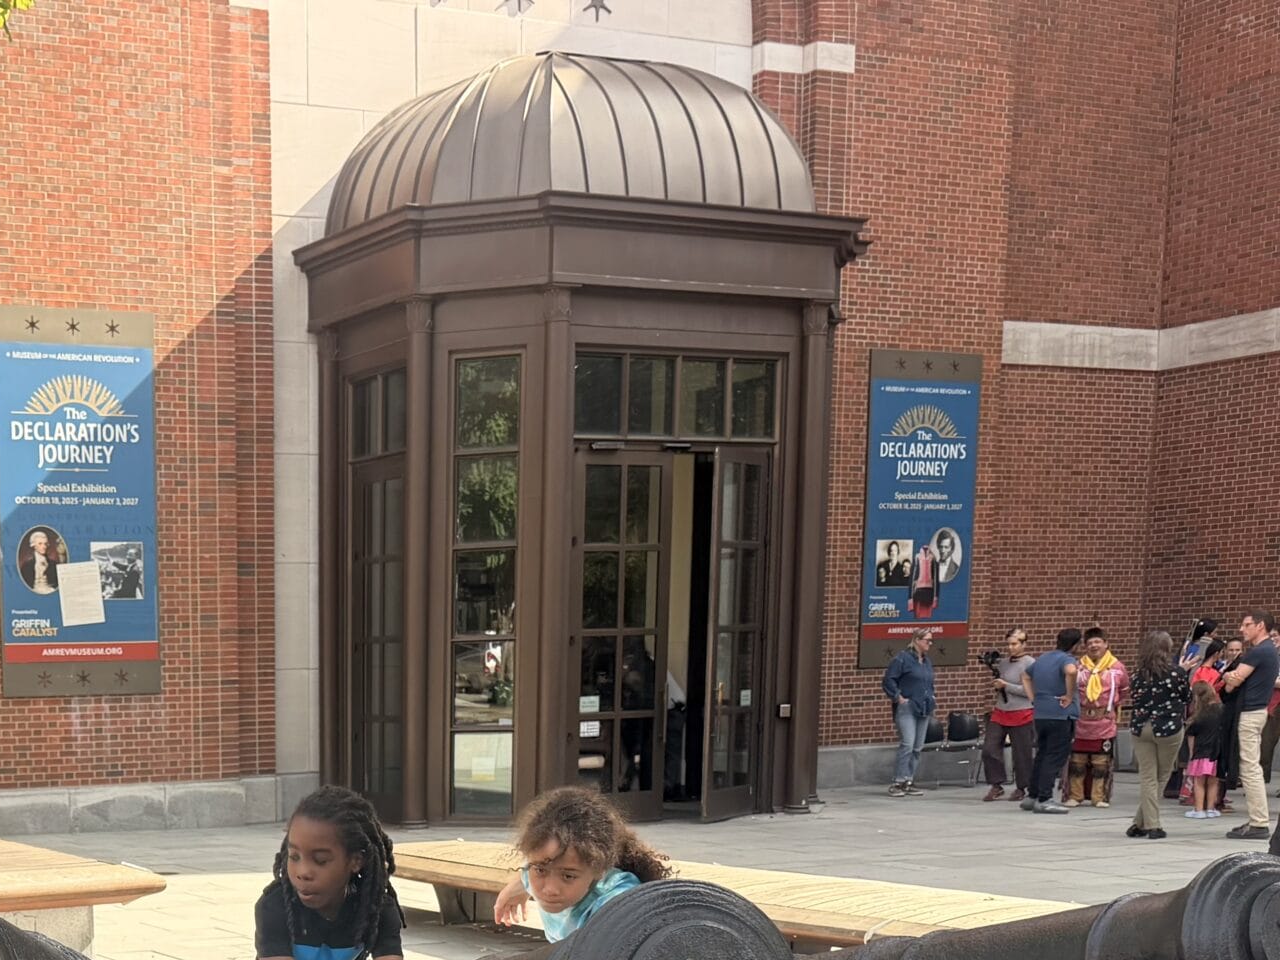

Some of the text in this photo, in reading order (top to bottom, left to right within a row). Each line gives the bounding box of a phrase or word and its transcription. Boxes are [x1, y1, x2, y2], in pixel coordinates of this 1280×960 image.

[12, 351, 41, 359] MUSEUM
[57, 353, 93, 362] AMERICAN
[94, 355, 134, 363] REVOLUTION
[64, 407, 87, 420] The
[10, 421, 140, 443] DECLARATION'S
[917, 431, 932, 440] The
[880, 442, 967, 459] DECLARATION'S
[38, 444, 113, 468] JOURNEY
[896, 460, 948, 480] JOURNEY
[37, 483, 117, 494] Special Exhibition
[15, 496, 50, 505] OCTOBER
[62, 497, 78, 505] 2025
[82, 497, 114, 506] JANUARY
[894, 491, 949, 501] Special Exhibition
[869, 603, 895, 611] GRIFFIN
[11, 619, 51, 628] GRIFFIN
[12, 627, 58, 637] CATALYST
[42, 647, 123, 656] AMREVMUSEUM.ORG
